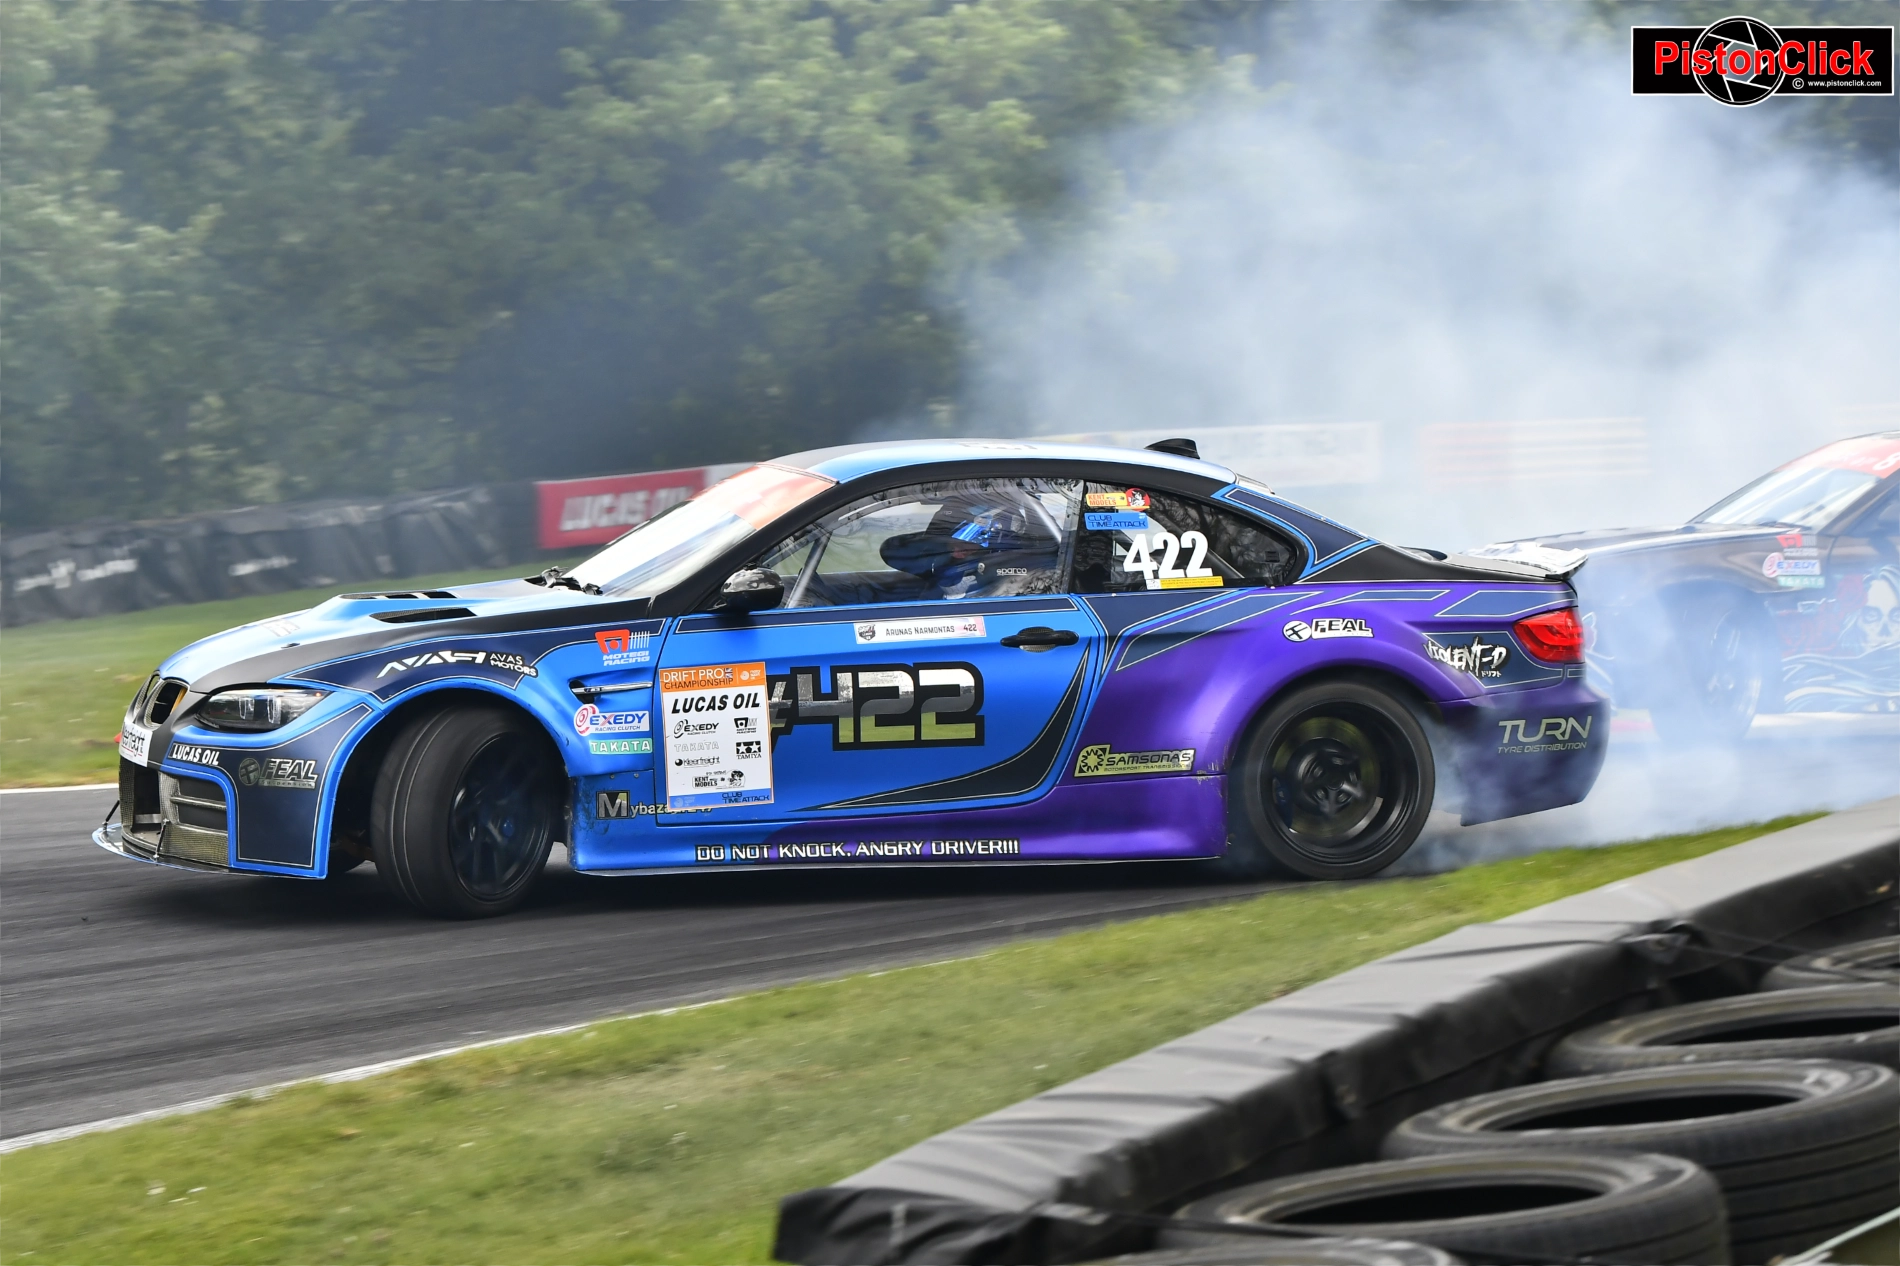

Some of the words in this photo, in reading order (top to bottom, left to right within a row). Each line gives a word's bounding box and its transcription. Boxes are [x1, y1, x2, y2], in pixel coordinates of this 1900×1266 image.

[1123, 530, 1213, 580] 422
[1776, 561, 1818, 569] EXEDY
[886, 628, 913, 636] ARUNAS
[914, 626, 955, 634] NARMONTAS
[963, 624, 977, 632] 422
[1314, 619, 1370, 633] FEAL
[490, 653, 523, 665] AVAS
[603, 651, 649, 660] MOTEGI
[604, 656, 650, 666] RACING
[1423, 637, 1507, 676] VIOLENT-D
[490, 659, 537, 676] MOTORS
[663, 670, 696, 683] DRIFT
[698, 668, 724, 679] PRO
[664, 678, 734, 689] CHAMPIONSHIP
[671, 694, 729, 714] LUCAS
[732, 692, 760, 709] OIL
[590, 713, 647, 726] EXEDY
[684, 722, 719, 732] EXEDY
[1498, 716, 1592, 743] TURN
[591, 741, 651, 752] TAKATA
[674, 741, 719, 752] TAKATA
[1524, 742, 1587, 753] DISTRIBUTION
[172, 744, 201, 762] LUCAS
[201, 750, 220, 766] OIL
[684, 756, 720, 766] Kleerfreight
[1106, 752, 1191, 766] SAMSONAS
[262, 759, 318, 781] FEAL
[697, 846, 724, 861] DO
[732, 845, 771, 859] NOT
[855, 842, 923, 857] ANGRY
[931, 840, 1019, 855] DRIVER!!!
